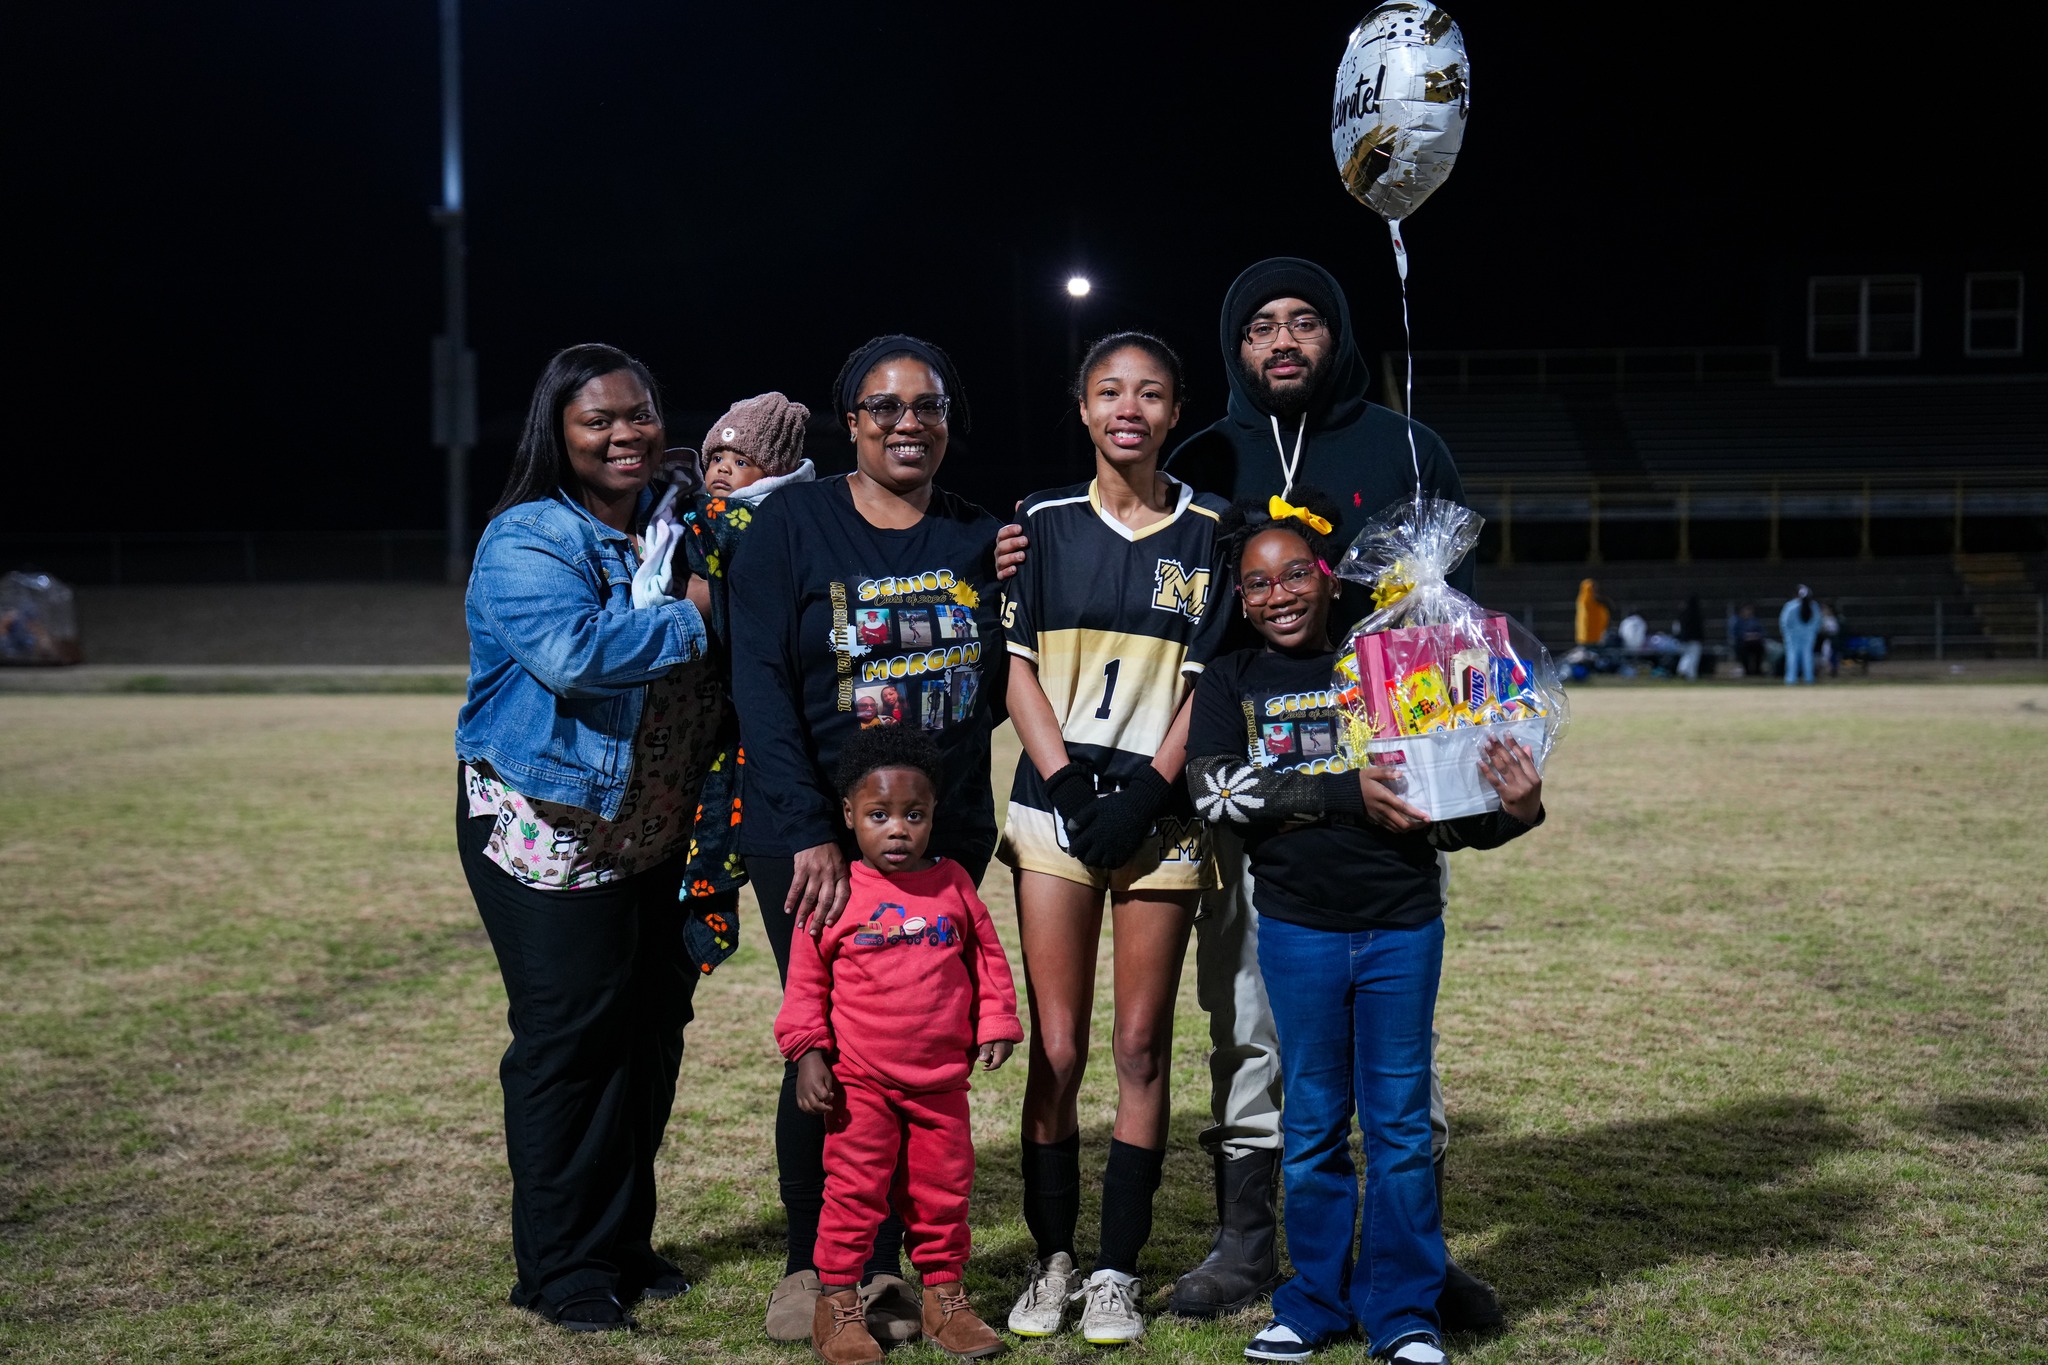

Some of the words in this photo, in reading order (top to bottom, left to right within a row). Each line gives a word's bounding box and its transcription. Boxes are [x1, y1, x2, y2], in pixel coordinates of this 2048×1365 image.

[858, 569, 957, 601] SENIOR
[874, 591, 903, 607] Class
[905, 593, 917, 607] of
[1152, 558, 1211, 624] M
[830, 581, 848, 645] MENDENHALL
[837, 649, 851, 673] HIGH
[862, 641, 981, 682] MORGAN
[838, 674, 853, 711] CHOOL
[1094, 657, 1121, 721] 1
[1241, 700, 1261, 757] MENDENHALL
[1159, 816, 1204, 866] M
